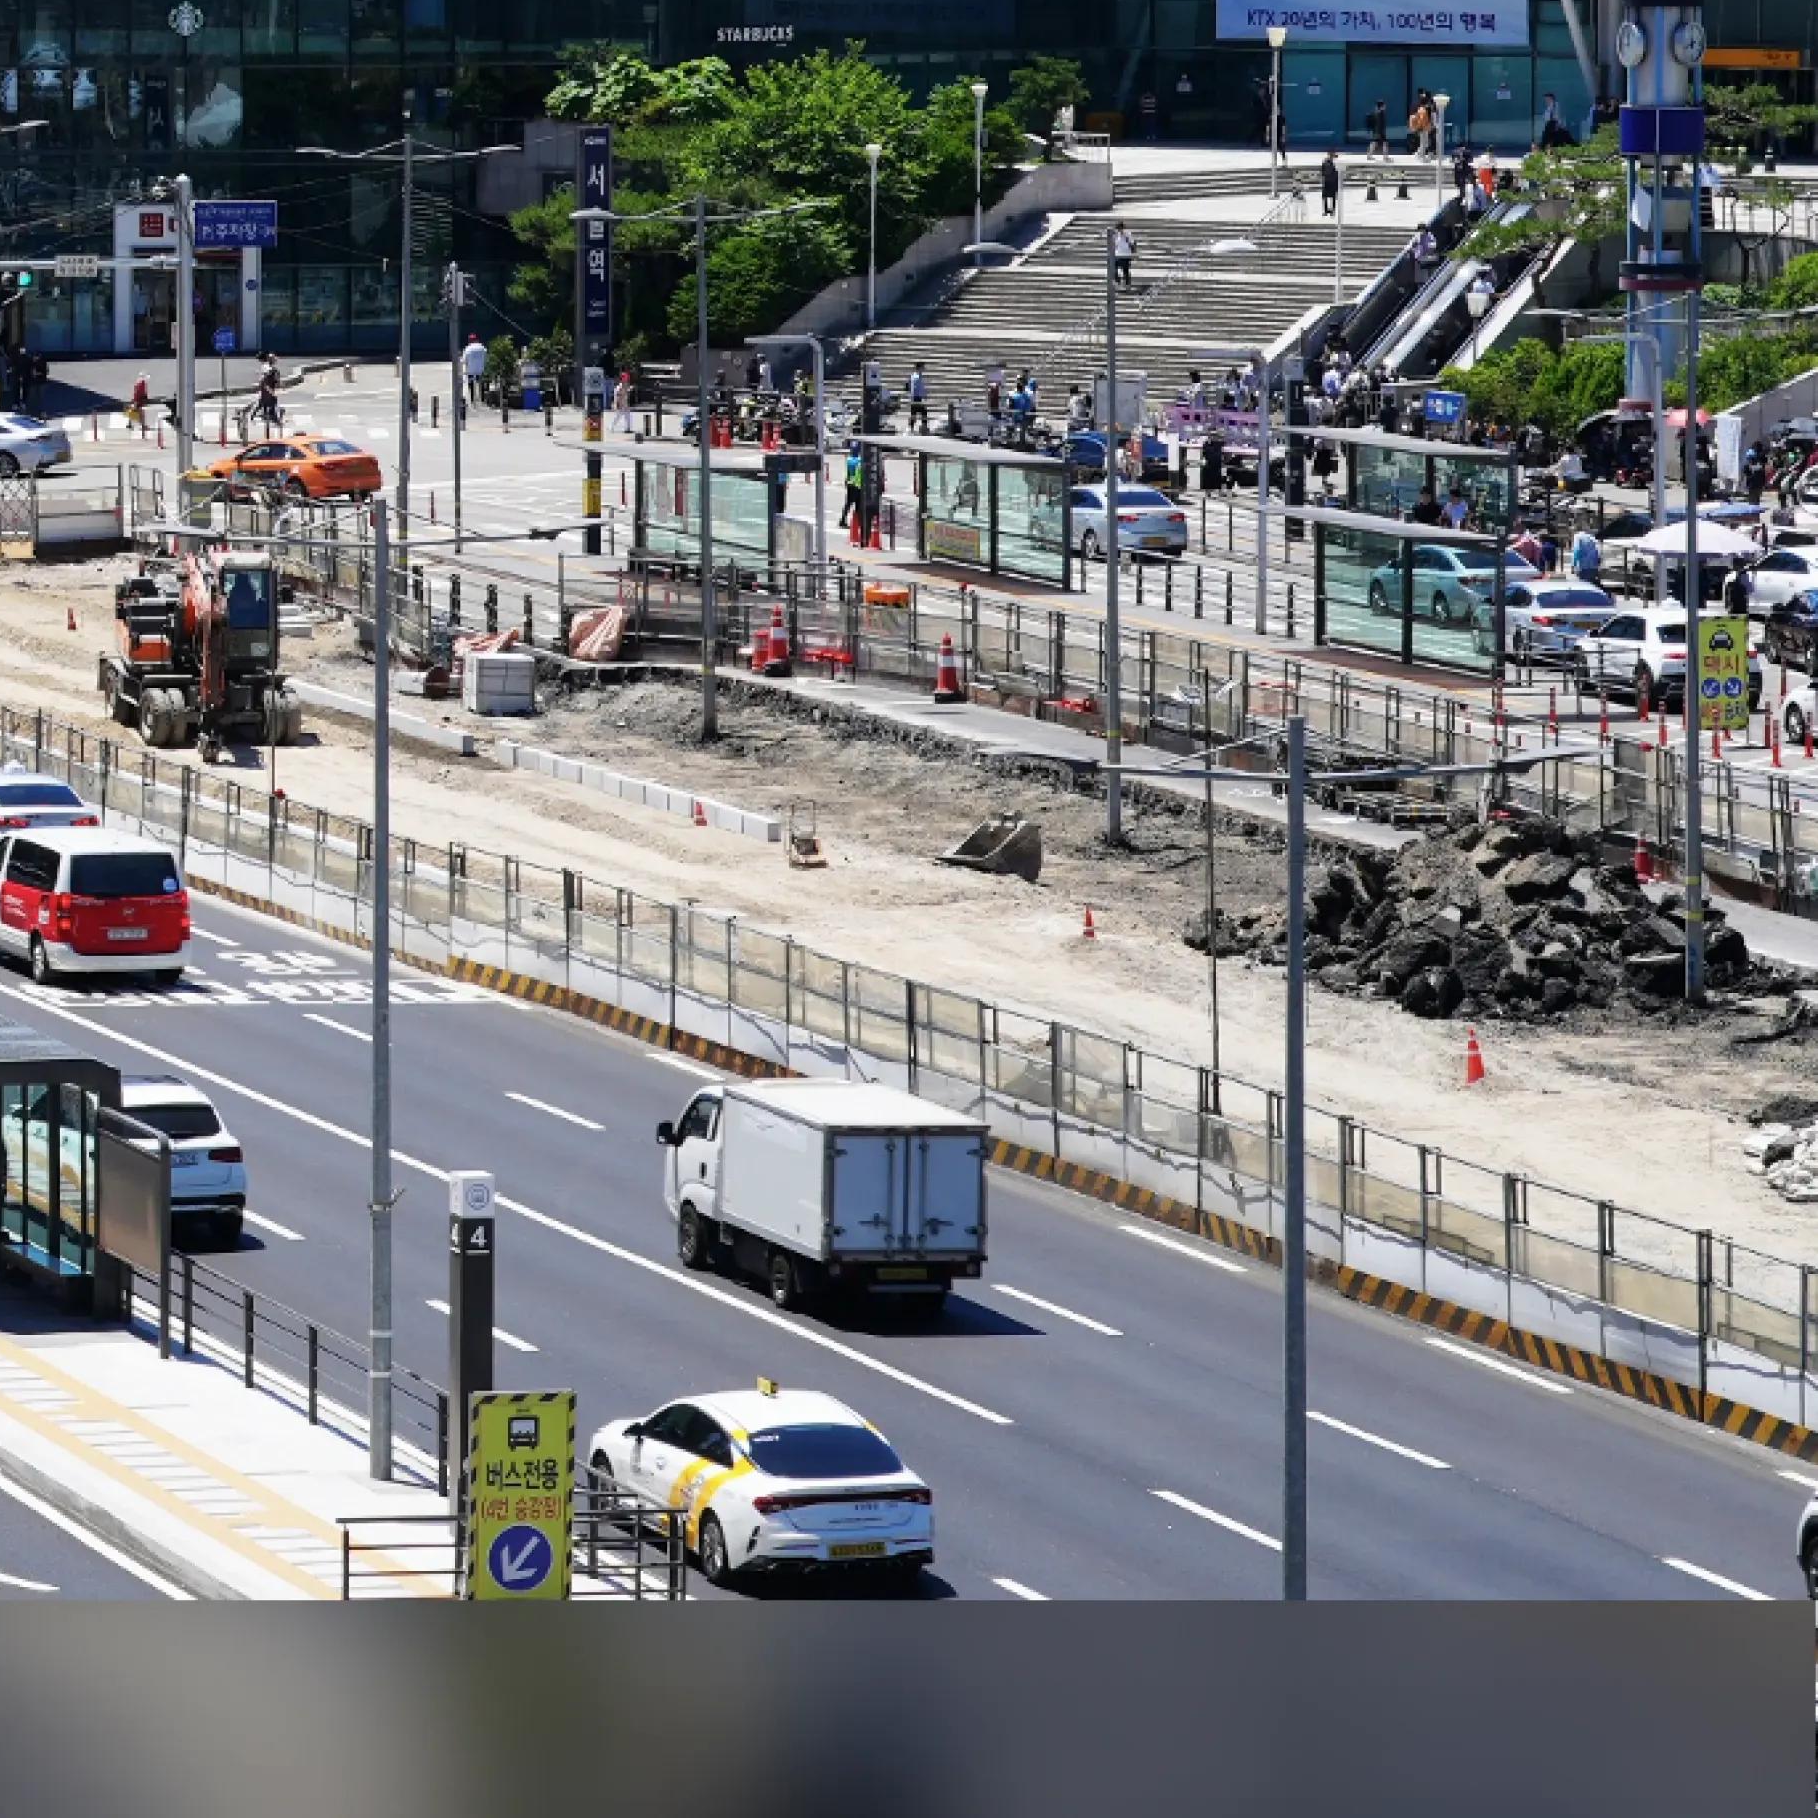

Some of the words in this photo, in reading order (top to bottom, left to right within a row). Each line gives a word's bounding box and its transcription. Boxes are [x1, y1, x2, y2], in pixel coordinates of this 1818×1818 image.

[1247, 8, 1276, 27] KTX
[1281, 10, 1336, 31] 20년의
[1387, 12, 1453, 32] 100년의
[1459, 12, 1496, 33] 행복
[717, 25, 793, 42] STARBUCKS
[470, 1225, 488, 1249] 4
[486, 1458, 559, 1492] 버스전용
[515, 1495, 562, 1522] 승강장)
